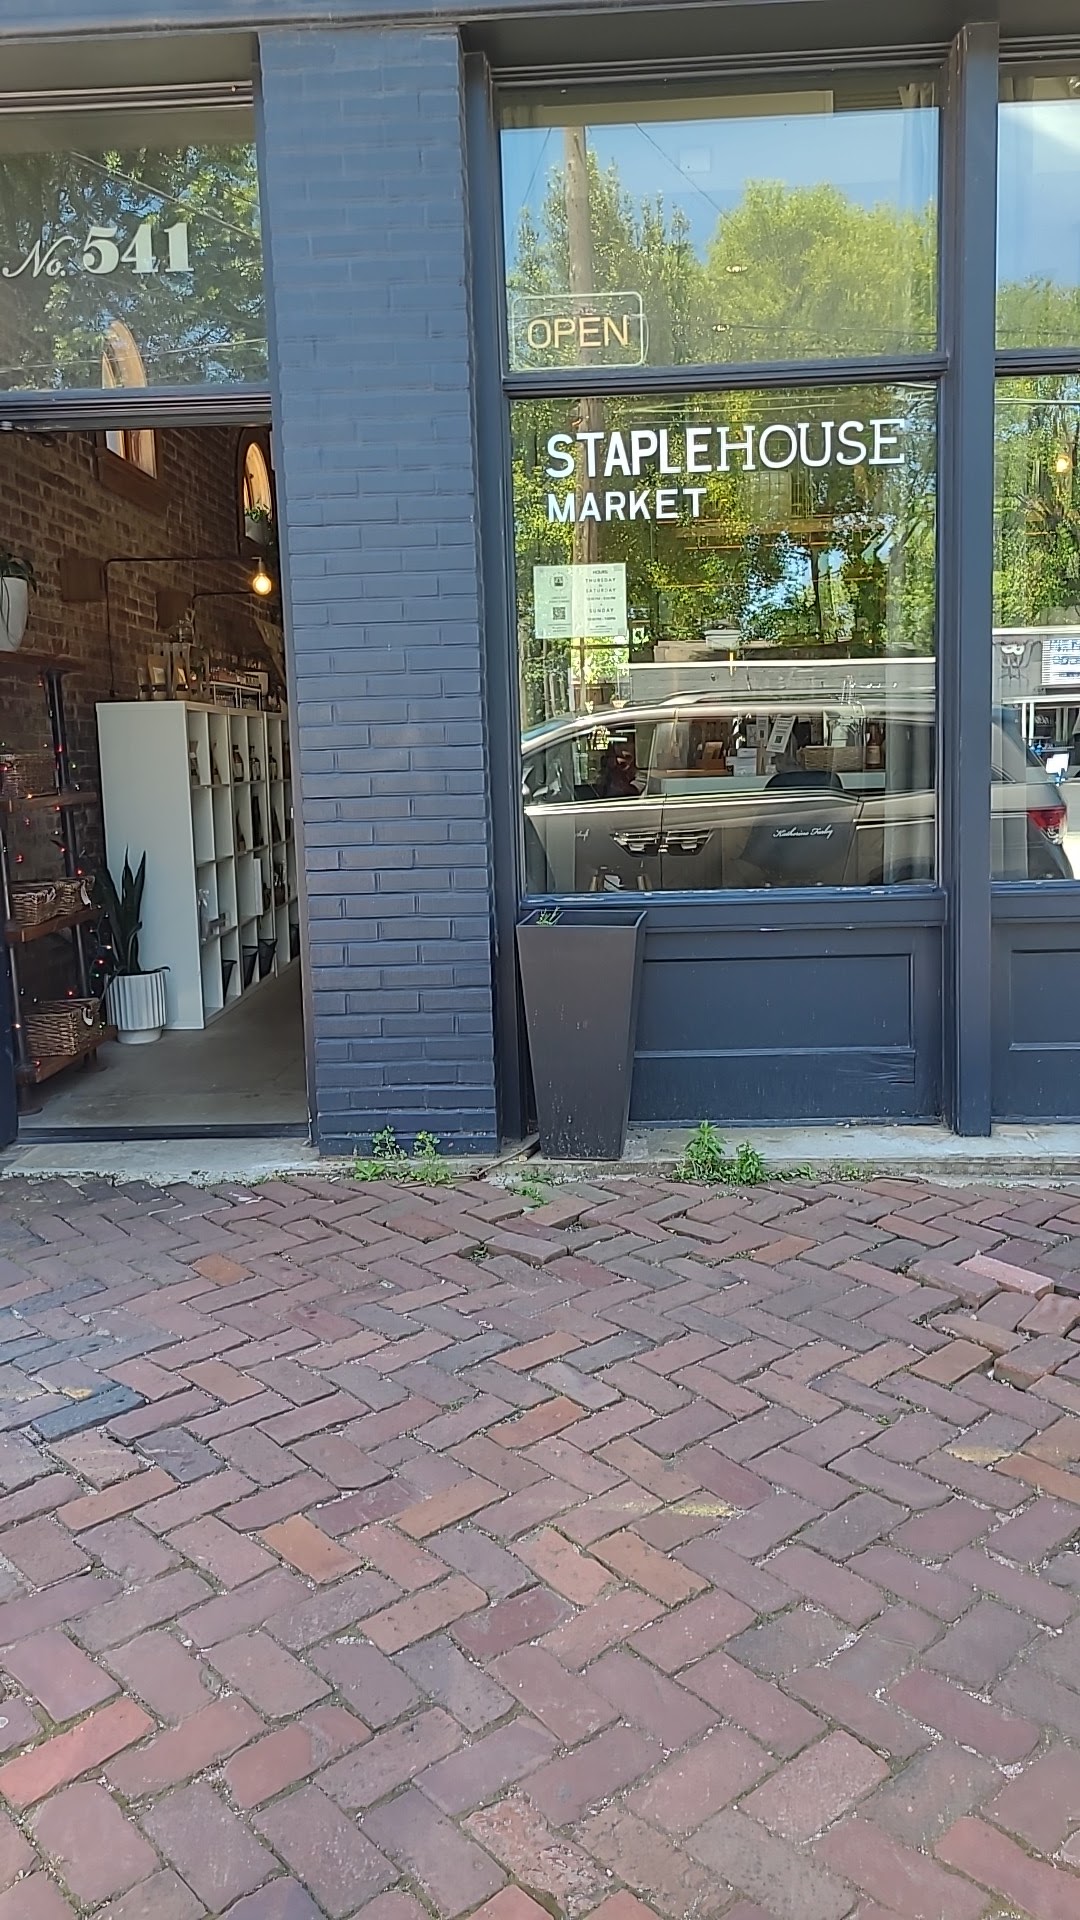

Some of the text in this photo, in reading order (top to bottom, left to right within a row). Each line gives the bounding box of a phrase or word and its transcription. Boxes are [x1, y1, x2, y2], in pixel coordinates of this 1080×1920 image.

[2, 222, 195, 278] No. 541
[527, 314, 630, 349] OPEN
[545, 418, 906, 479] STAPLEHOUSE
[546, 487, 708, 523] MARKET
